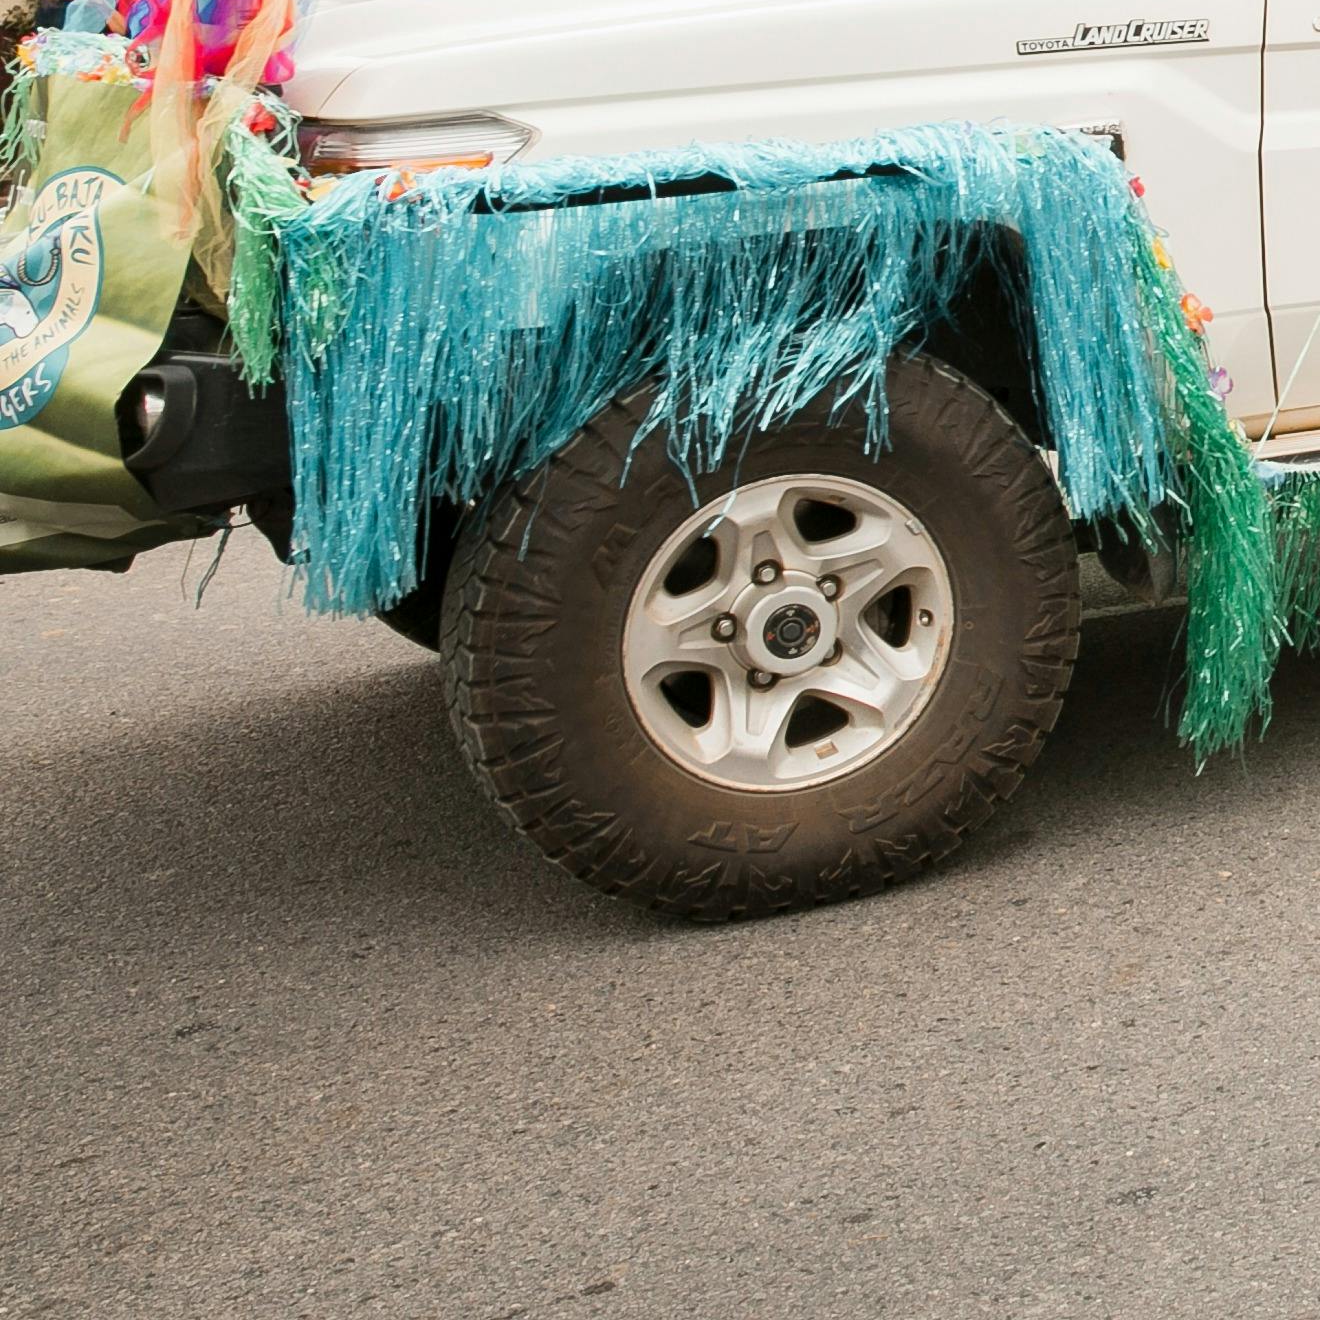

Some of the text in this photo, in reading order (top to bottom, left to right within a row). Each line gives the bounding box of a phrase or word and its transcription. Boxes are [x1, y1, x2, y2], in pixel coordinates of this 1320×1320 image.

[1020, 38, 1070, 52] TOYOTA
[2, 282, 85, 371] THE ANIMALS
